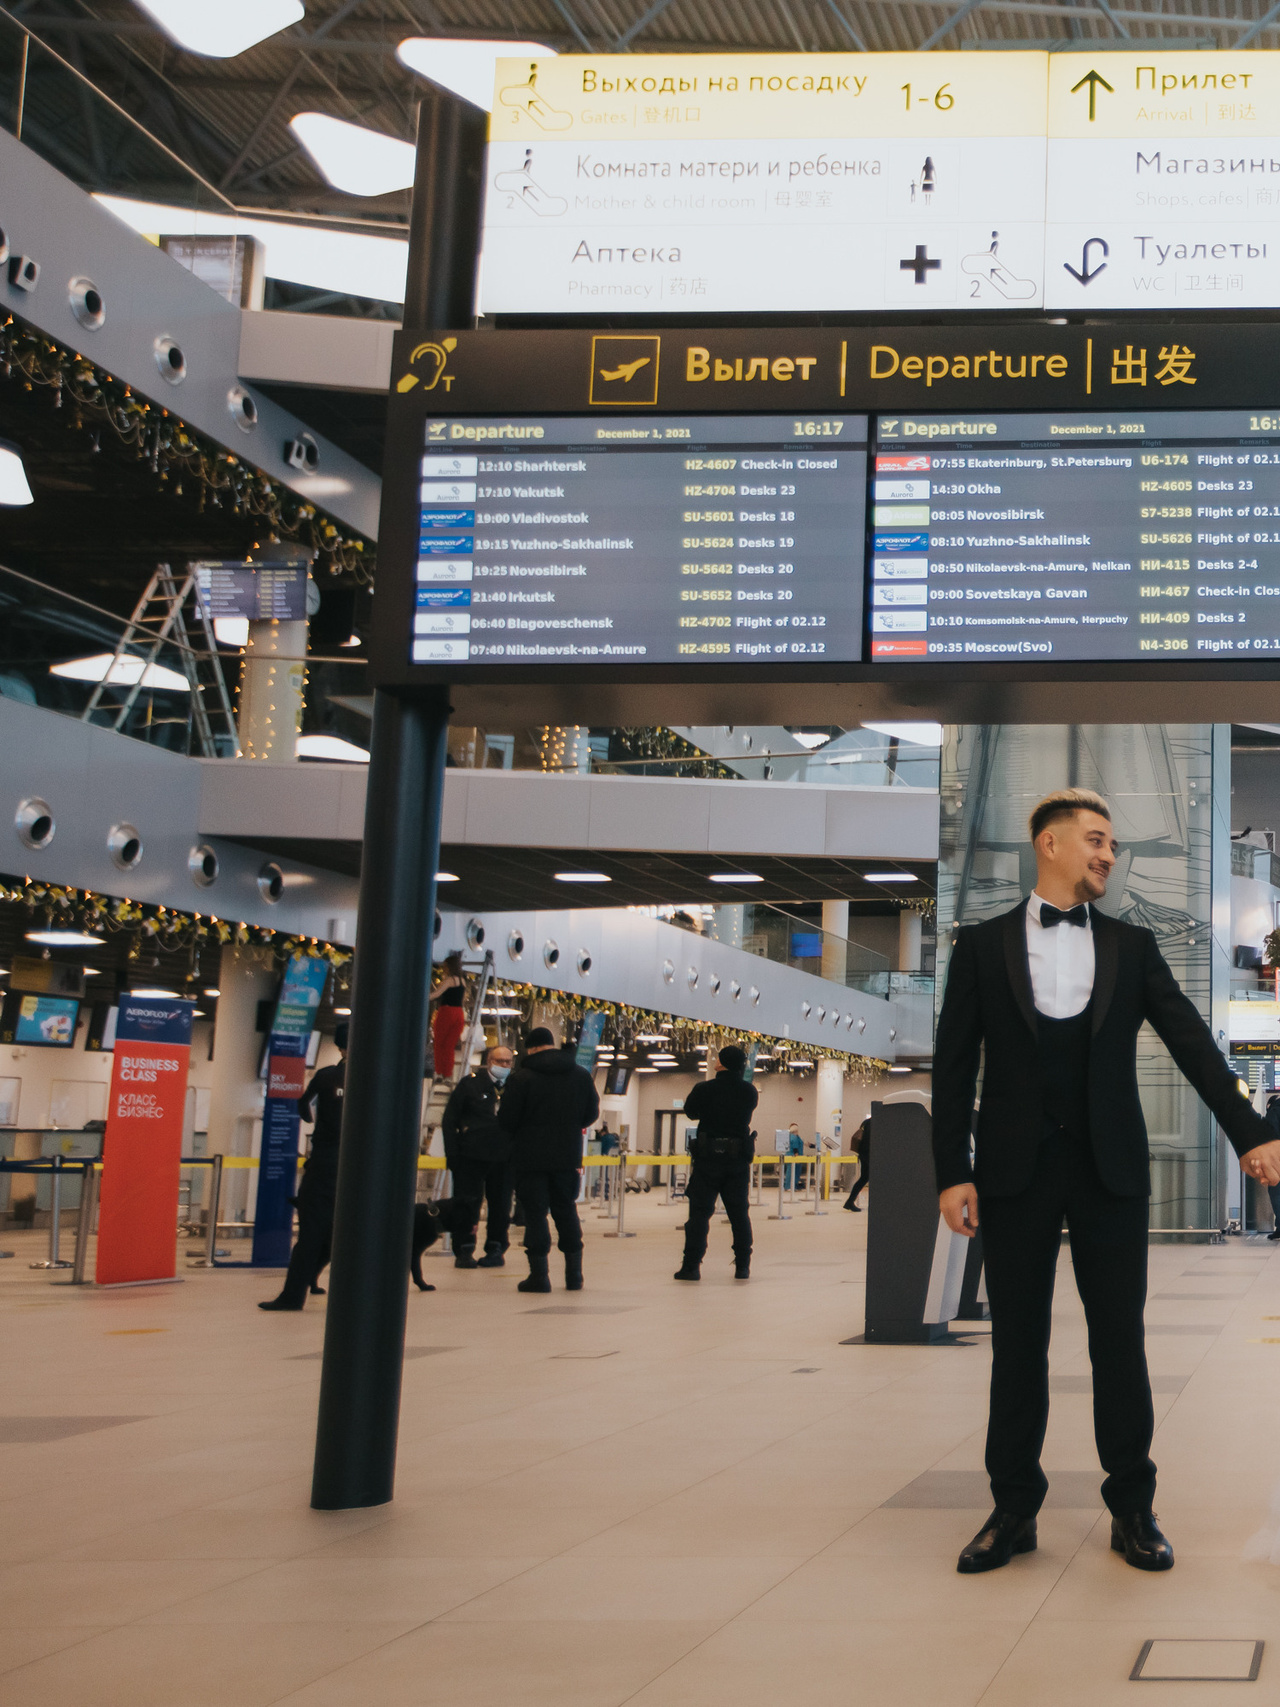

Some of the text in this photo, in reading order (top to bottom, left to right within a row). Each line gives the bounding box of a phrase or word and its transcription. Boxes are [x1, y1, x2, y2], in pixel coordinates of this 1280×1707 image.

[583, 70, 867, 96] Выходы на посадку
[1136, 67, 1252, 96] Прилет
[901, 83, 954, 110] 1-6
[510, 110, 520, 124] 3
[581, 109, 627, 124] Gates
[643, 106, 701, 124] 登机口
[1136, 106, 1193, 122] Arrival
[1217, 103, 1257, 121] 到达
[577, 154, 880, 182] Комната матери и ребенка
[506, 196, 515, 210] 2
[575, 193, 757, 209] Mother & child room
[1135, 191, 1243, 209] Shops, cafes
[572, 240, 680, 262] Аптека
[1134, 236, 1266, 265] Туалеты
[568, 280, 653, 300] Pharmacy
[669, 277, 708, 296] 药店
[970, 280, 981, 299] 2
[1133, 276, 1165, 292] WC
[1184, 274, 1244, 292] 卫生间
[687, 347, 816, 381] Вылет
[871, 346, 1067, 386] Departure
[1112, 345, 1197, 386] 出发
[452, 424, 544, 441] Departure
[597, 429, 690, 439] December 1, 2021
[795, 422, 843, 435] 16:17
[904, 422, 997, 438] Departure
[1051, 425, 1145, 434] December 1, 2021
[480, 459, 837, 471] 12:10 Sharhtersk HZ-4607 Check-in Closed
[932, 459, 965, 468] 07:55
[968, 458, 1046, 469] Ekaterinburg,
[1051, 457, 1132, 467] St.Petersburg
[1142, 455, 1188, 465] U6-174
[1198, 455, 1233, 466] Flight
[1237, 455, 1249, 464] of
[930, 563, 964, 573] 08:50
[966, 563, 1088, 572] Nikolaevsk-na-Amure,
[1093, 562, 1130, 570] Nelkan
[1198, 560, 1234, 569] Desks
[1239, 560, 1258, 569] 2-4
[471, 617, 825, 631] 06:40 Blagoveschensk HZ-4702 Flight of 02.12
[929, 643, 962, 652] 09:35
[965, 641, 1052, 653] Moscow(Svo)
[1141, 640, 1188, 650] N4-306
[1198, 640, 1233, 651] Flight
[1237, 639, 1250, 649] of
[121, 1056, 179, 1071] BUSINESS
[120, 1069, 157, 1082] CLASS
[271, 1074, 286, 1083] SKY
[270, 1083, 303, 1092] PRIORITY
[118, 1093, 156, 1106] КЛАСС
[117, 1105, 164, 1119] БИЗНЕС
